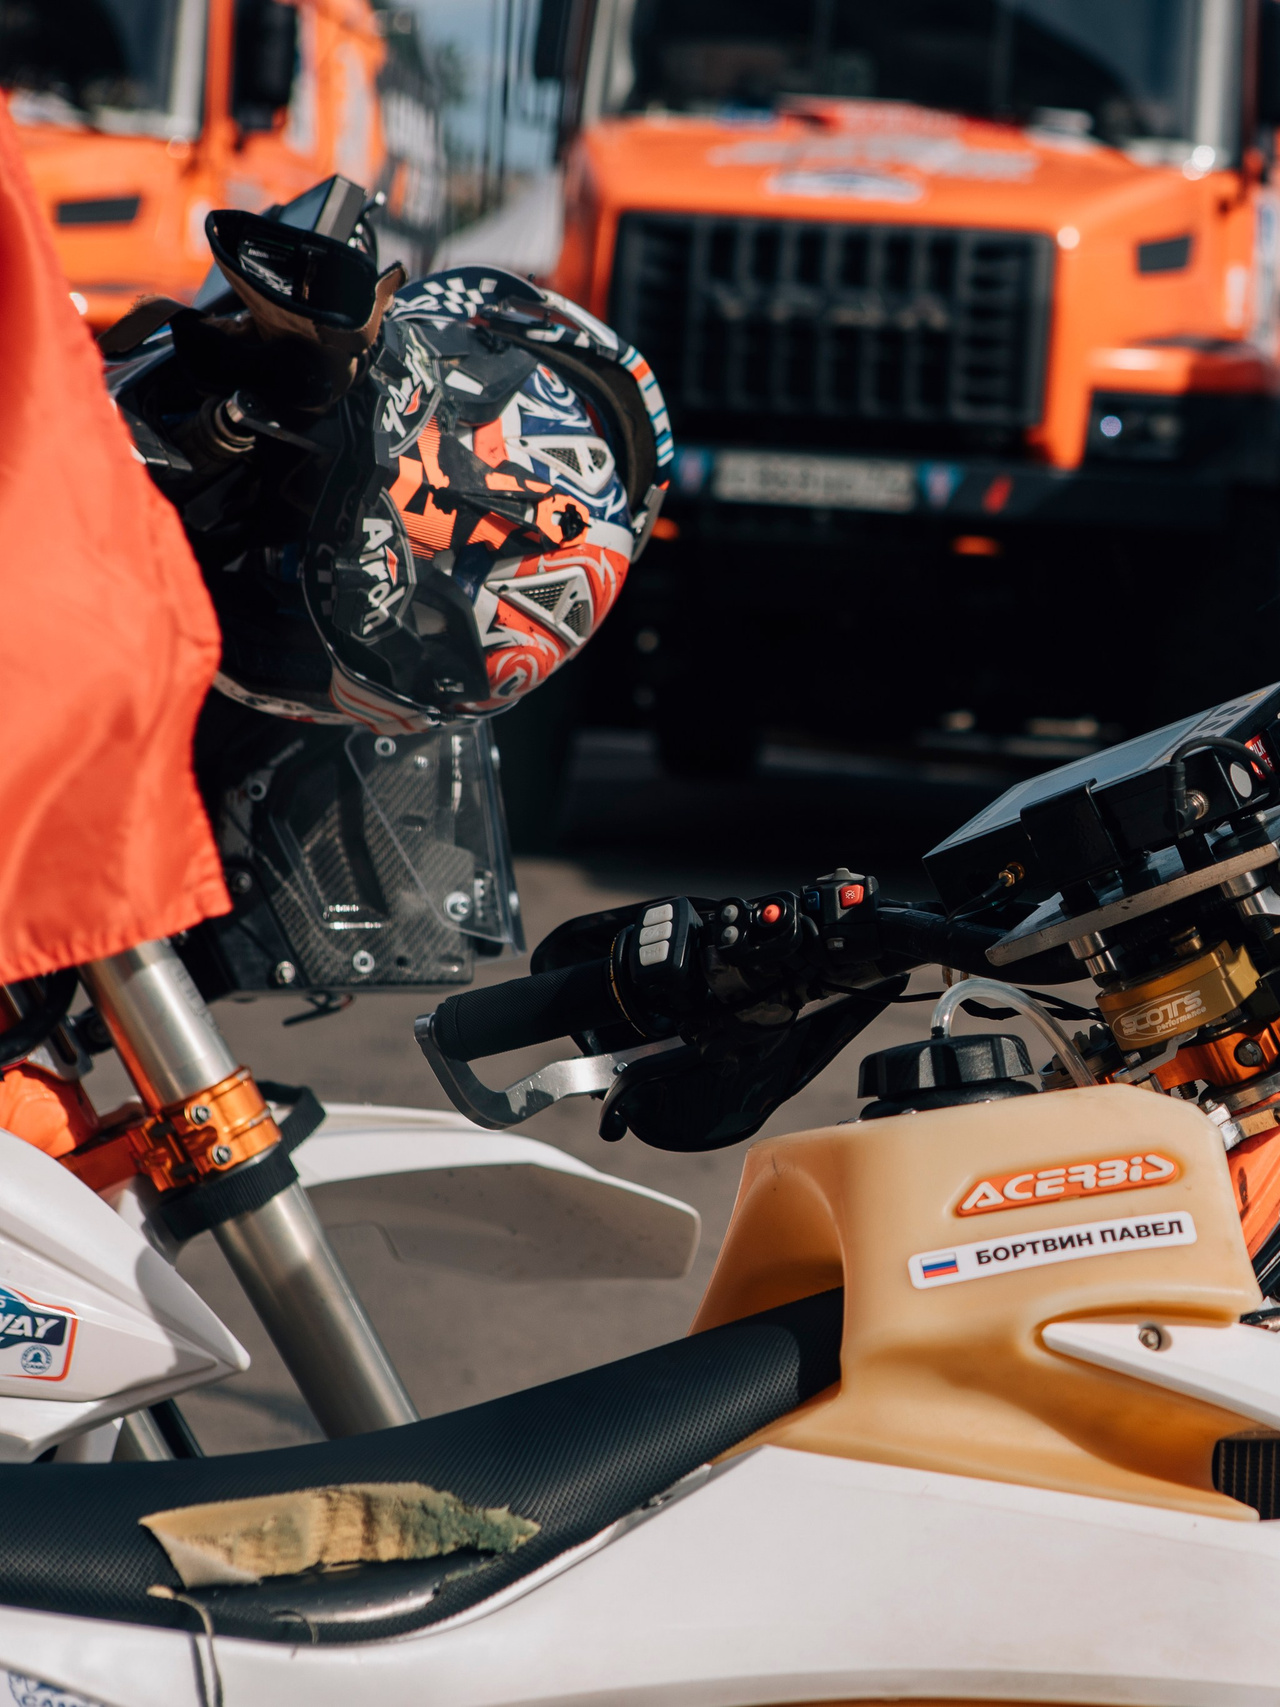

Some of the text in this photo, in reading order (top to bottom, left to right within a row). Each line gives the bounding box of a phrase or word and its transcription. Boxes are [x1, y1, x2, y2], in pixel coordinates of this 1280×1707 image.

[1121, 990, 1202, 1036] SCOTTS
[1157, 1006, 1207, 1033] performance
[976, 1220, 1184, 1266] БОРТВИН ПАВЕЛ
